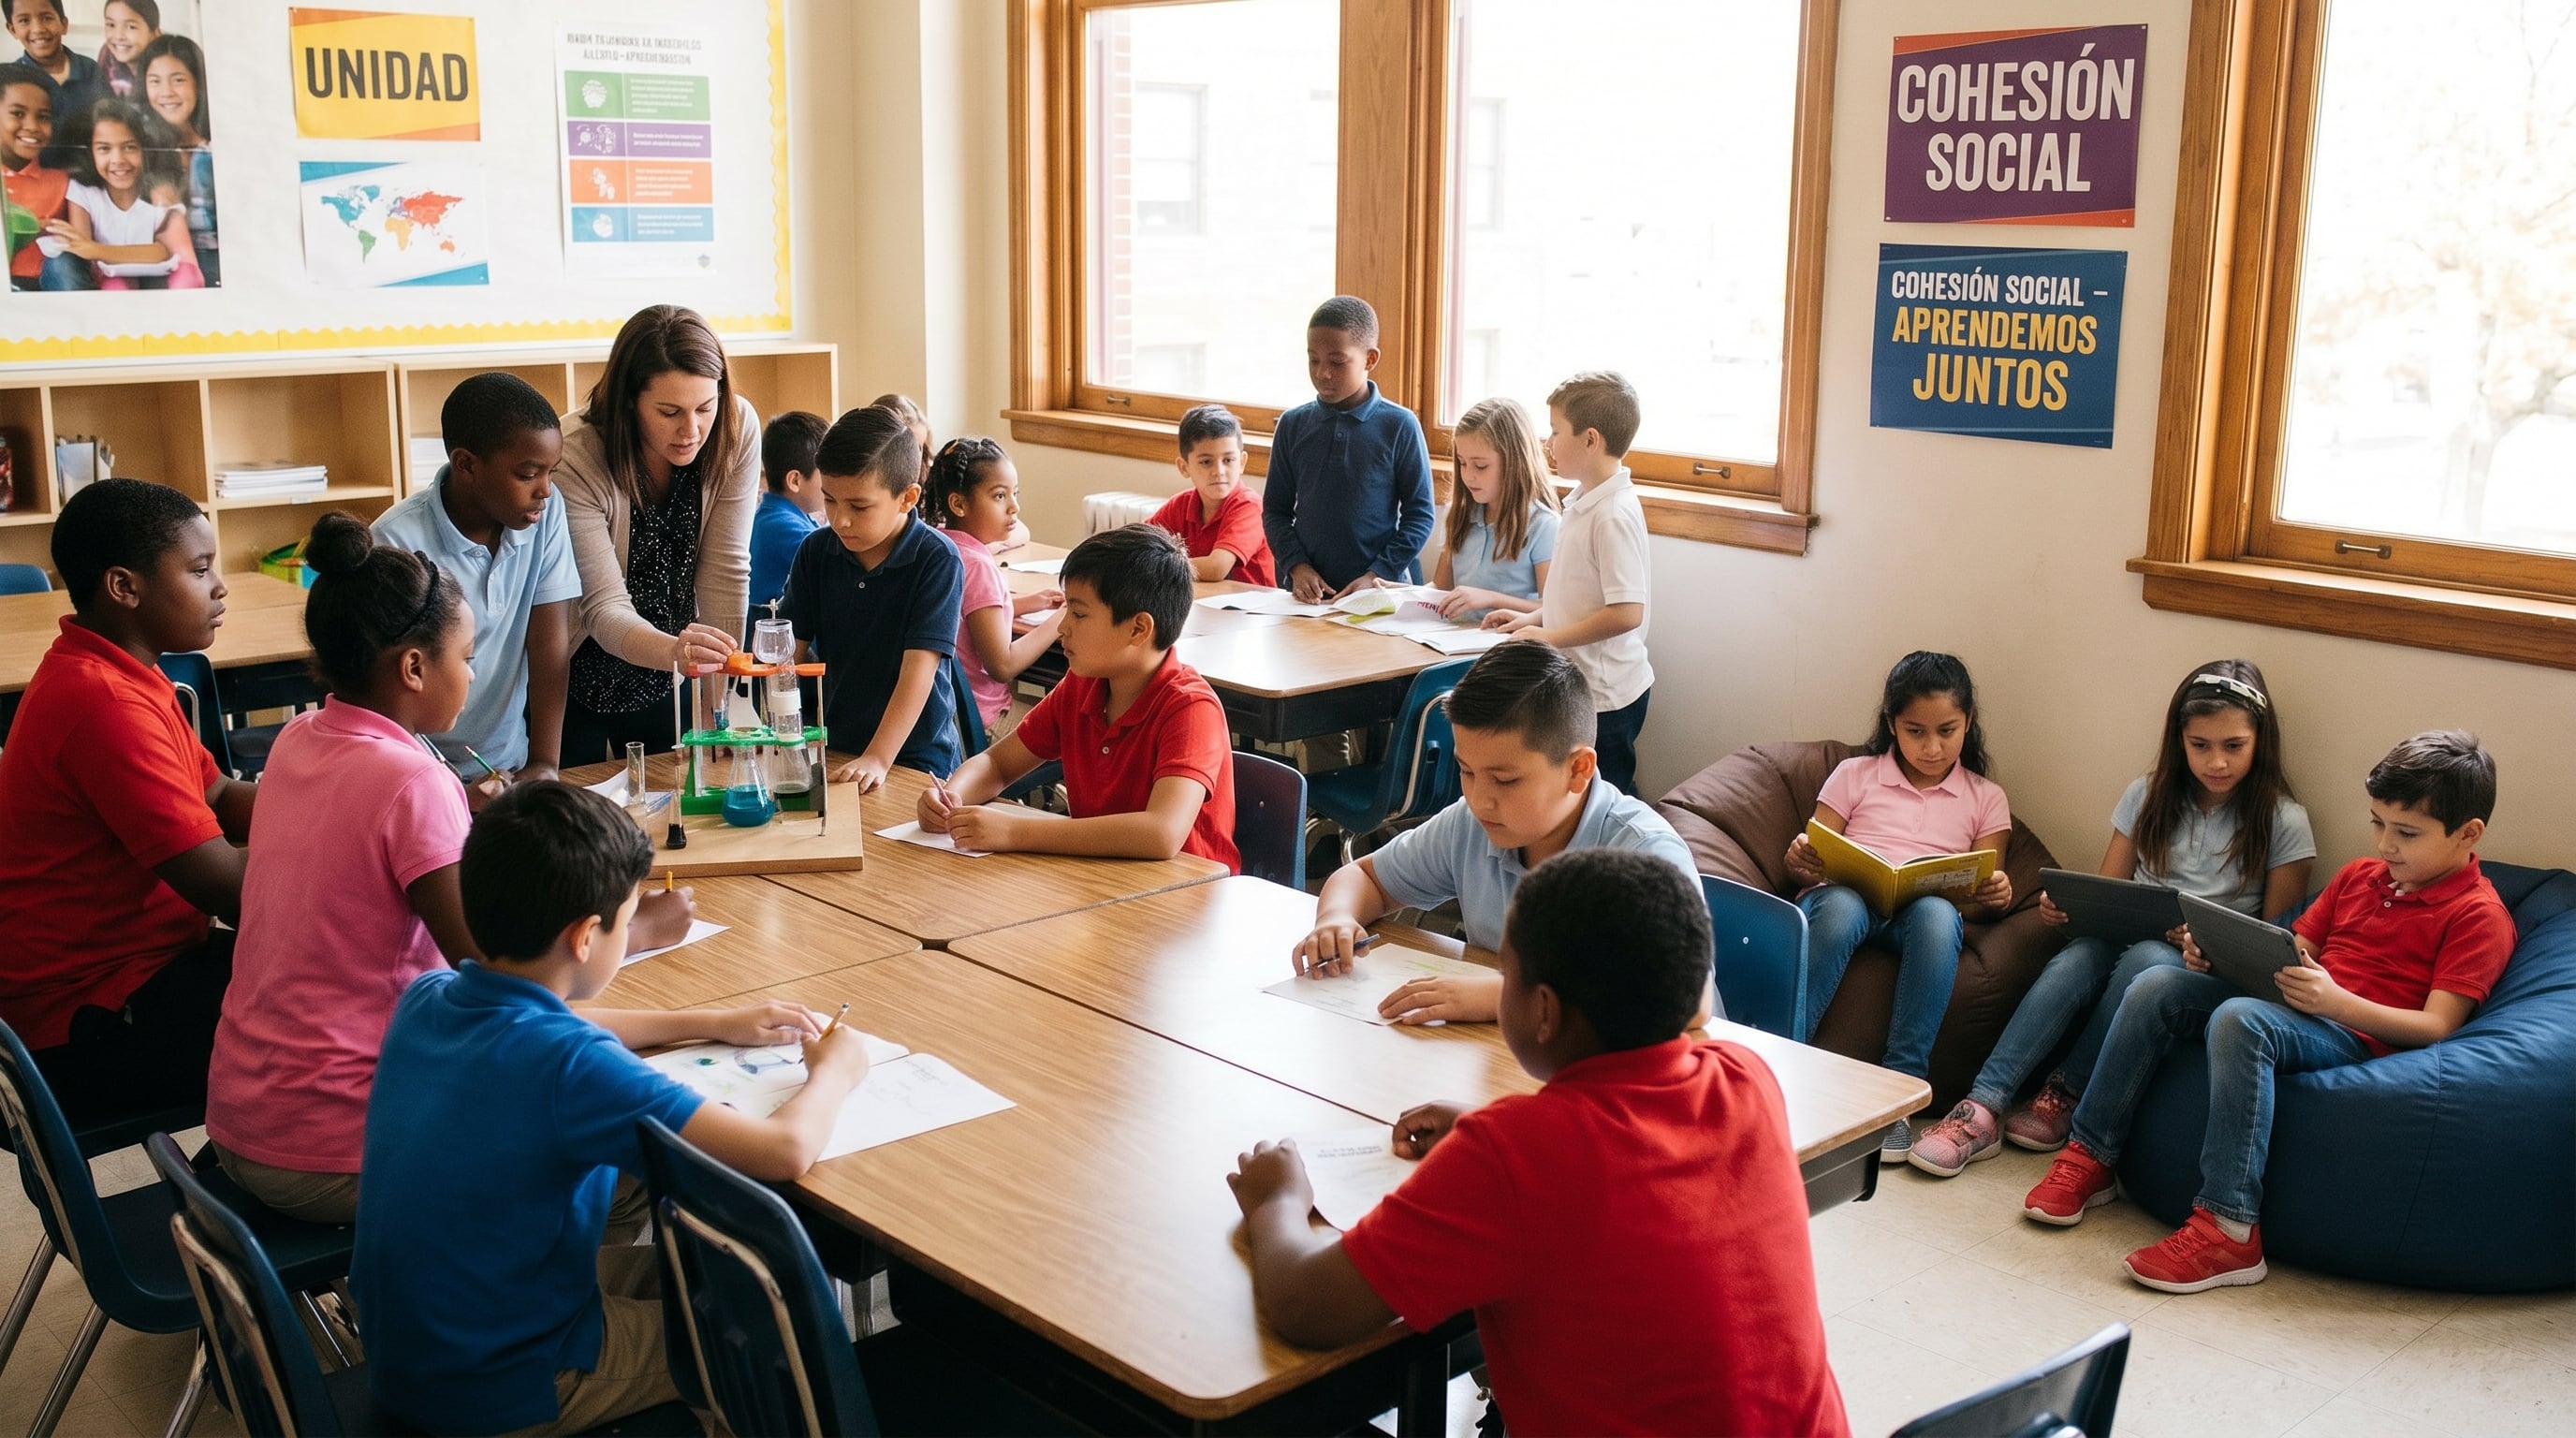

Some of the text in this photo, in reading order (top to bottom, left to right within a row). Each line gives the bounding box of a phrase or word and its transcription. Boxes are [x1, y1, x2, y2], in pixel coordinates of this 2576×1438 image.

[305, 47, 469, 102] UNIDAD
[1896, 42, 2135, 124] COHESIÓN
[1925, 132, 2091, 192] SOCIAL
[1891, 266, 1999, 302] COHESIÓN
[2005, 274, 2085, 307] SOCIAL
[1891, 305, 2098, 355] APRENDEMOS
[1912, 352, 2069, 411] JUNTOS
